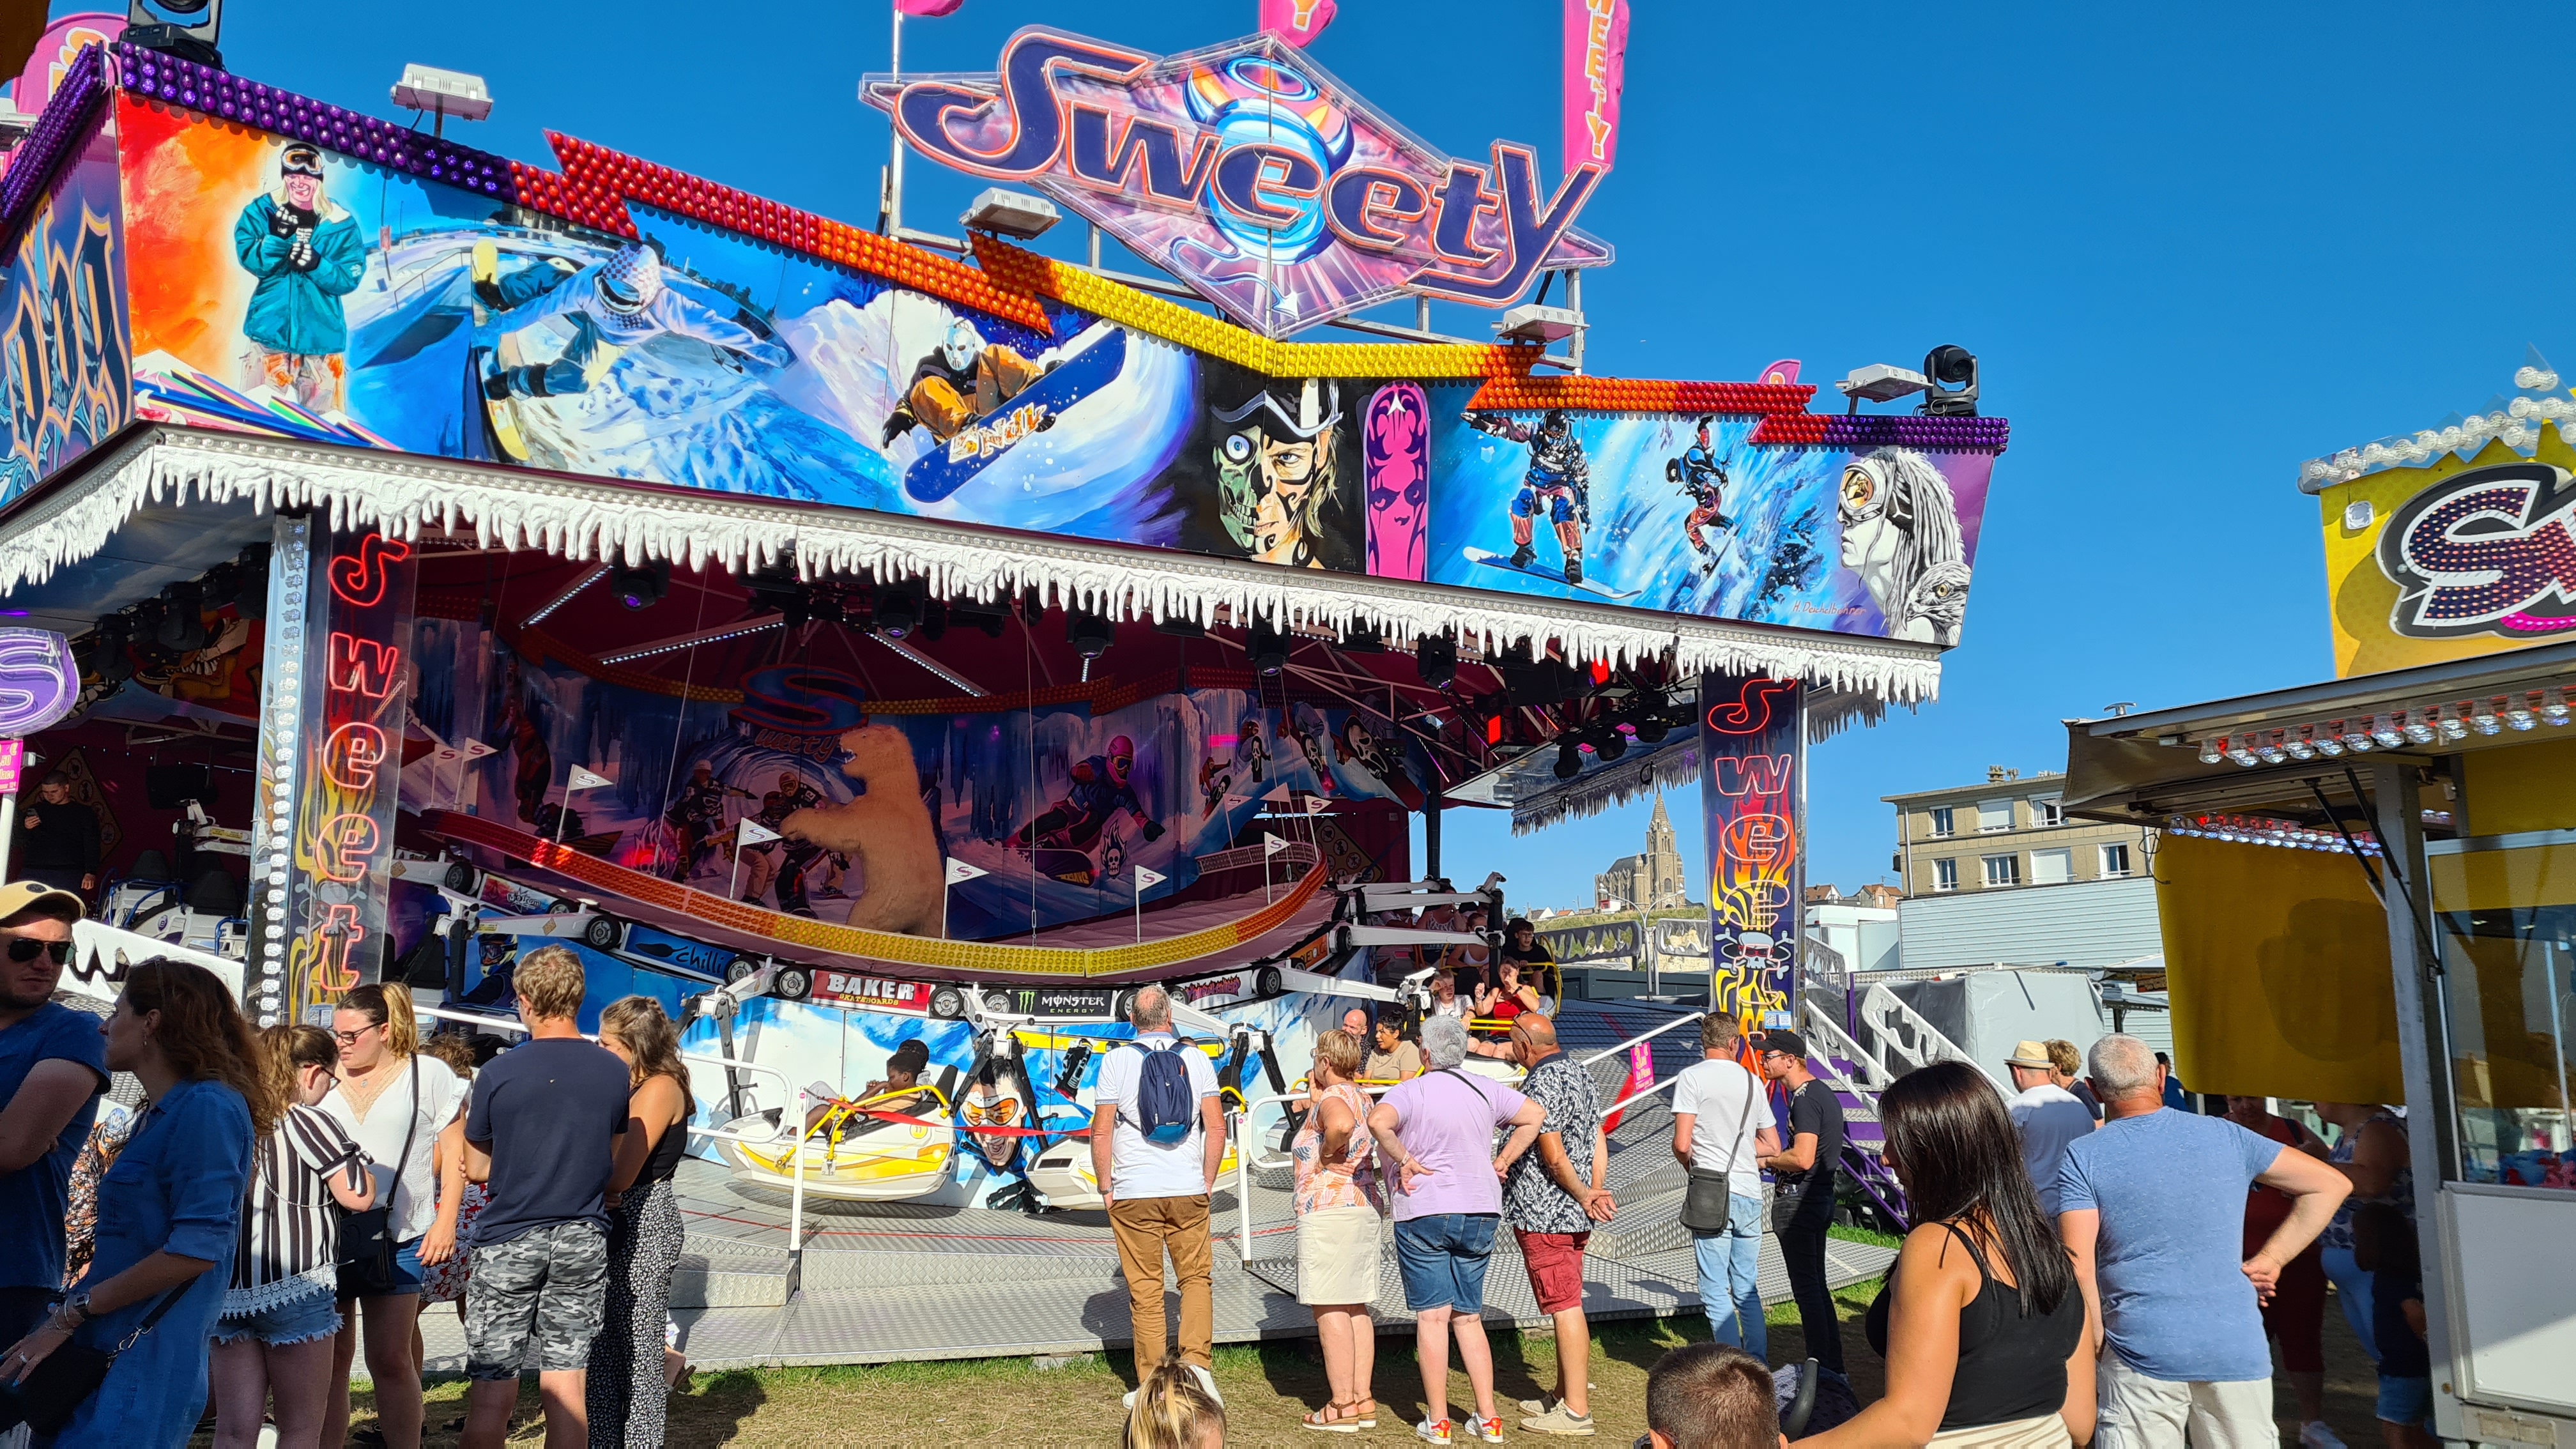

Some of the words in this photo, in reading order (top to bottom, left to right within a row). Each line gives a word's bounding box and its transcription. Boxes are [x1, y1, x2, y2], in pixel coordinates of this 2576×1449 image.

[896, 31, 1605, 307] Sweety
[0, 769, 15, 780] lace
[827, 974, 915, 1000] BAKER
[839, 993, 900, 1006] SKATEBOARDS
